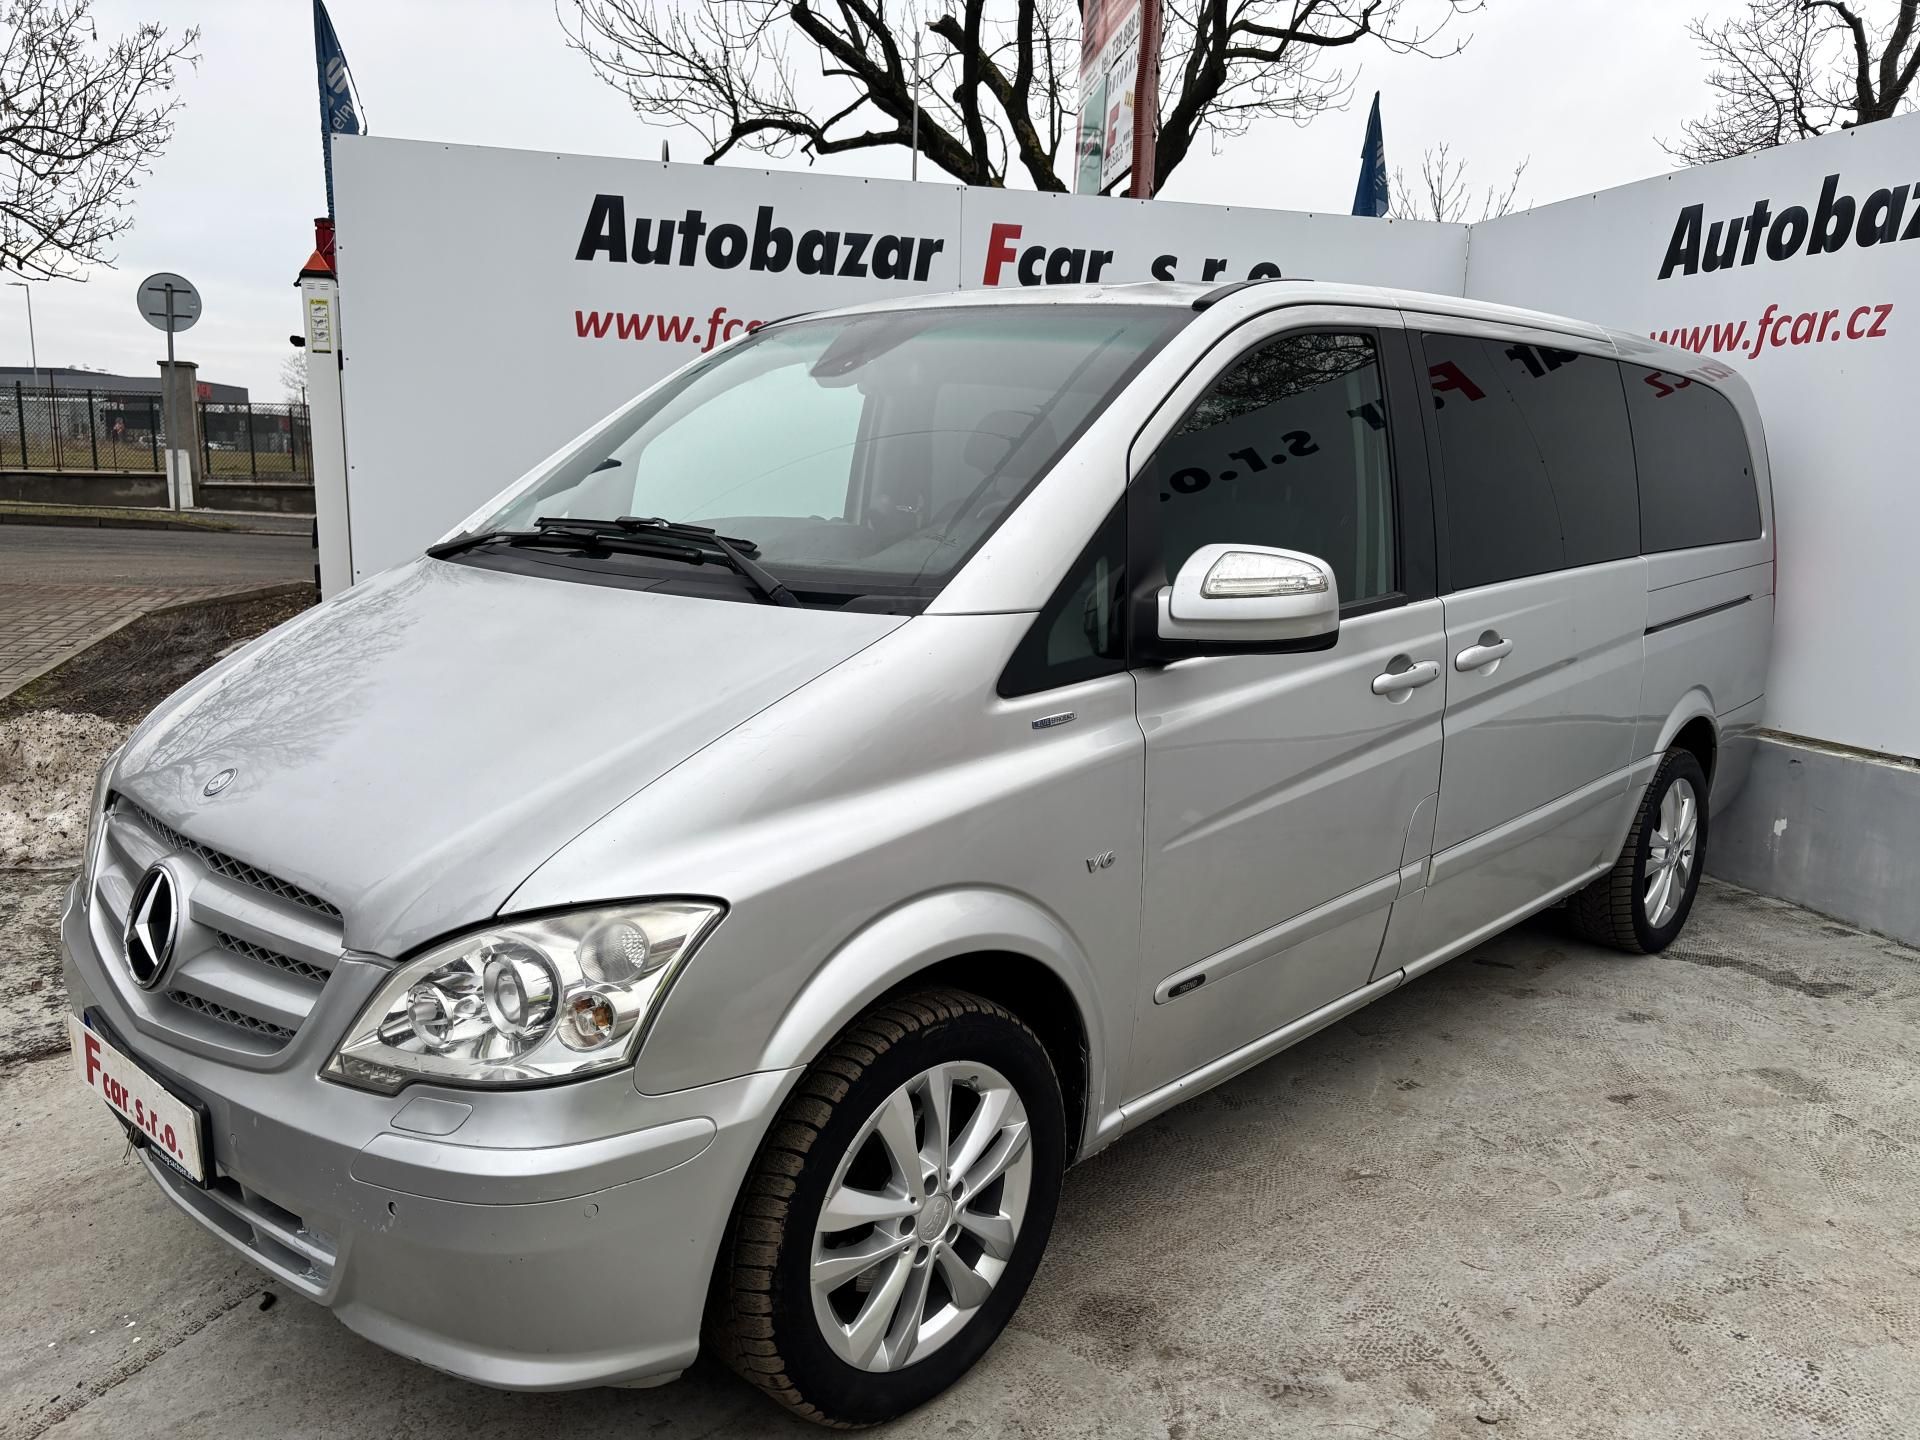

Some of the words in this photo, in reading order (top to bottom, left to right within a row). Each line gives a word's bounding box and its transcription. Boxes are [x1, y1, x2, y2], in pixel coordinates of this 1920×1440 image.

[575, 194, 944, 281] Autobazar
[983, 222, 1113, 286] Fcar
[1086, 851, 1116, 873] V6
[135, 1098, 184, 1160] s.r.o.
